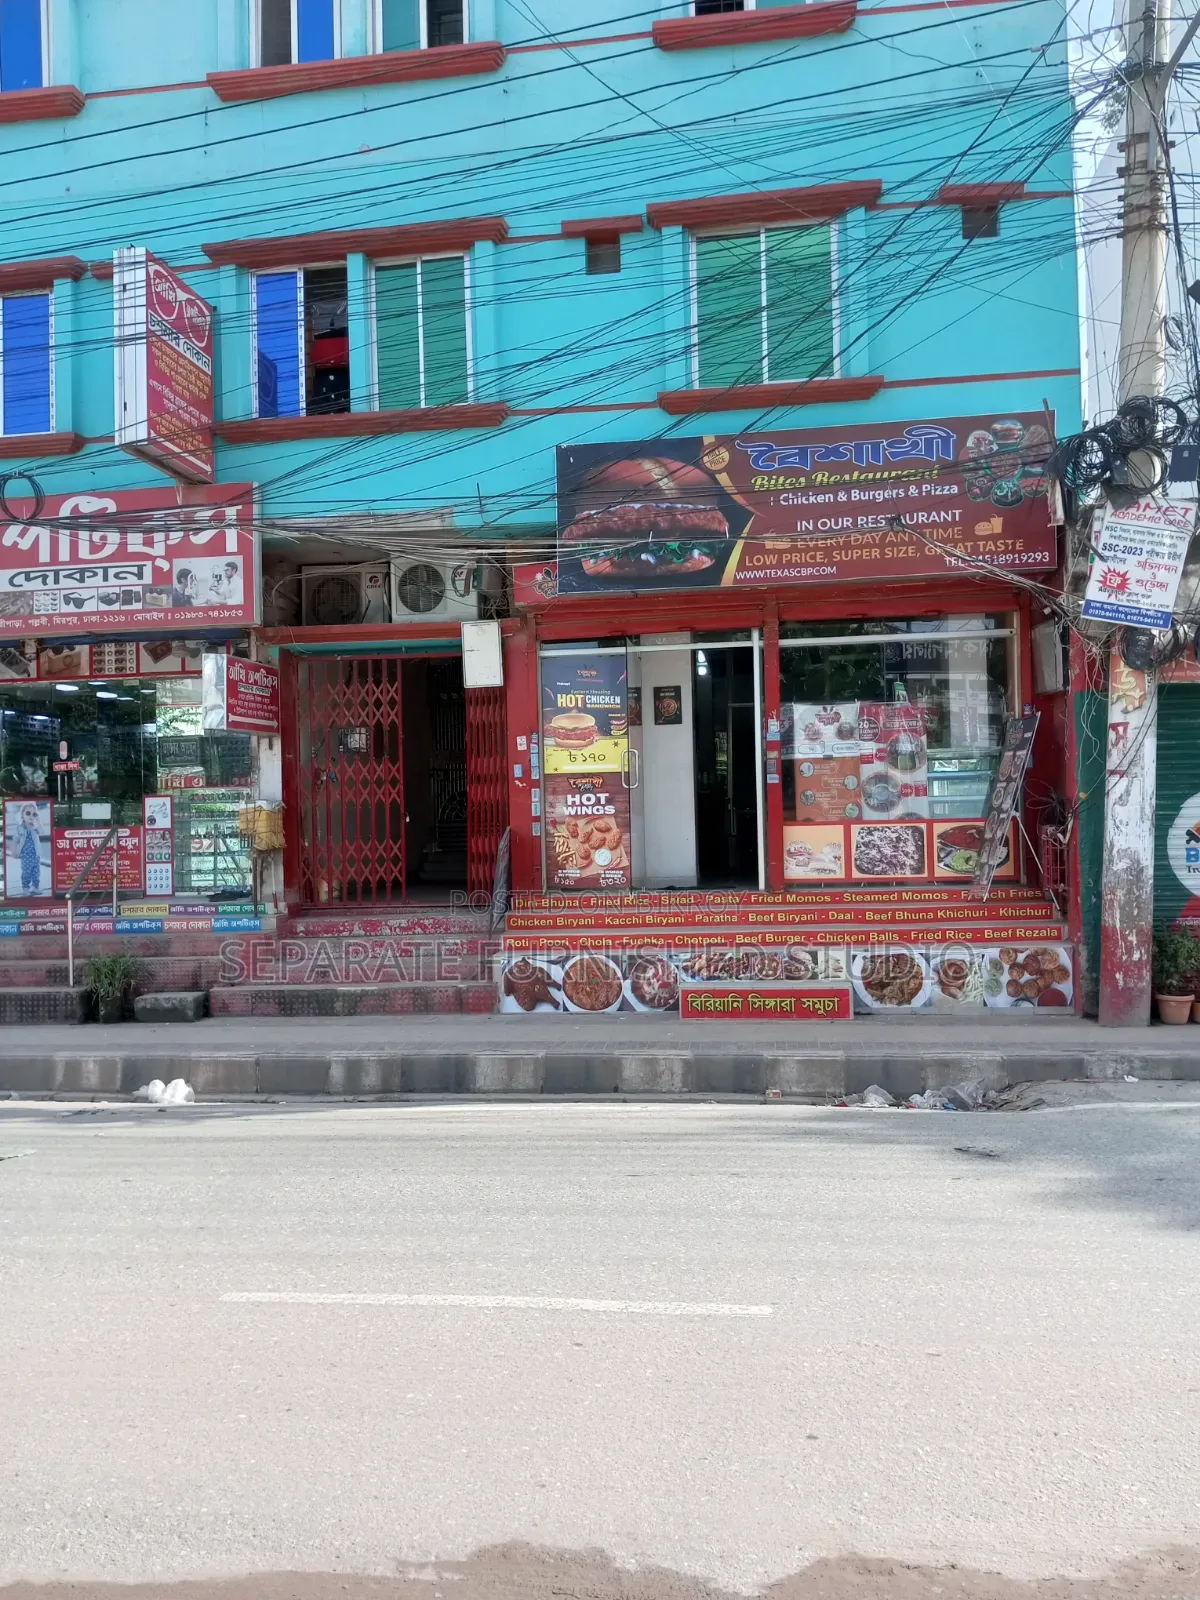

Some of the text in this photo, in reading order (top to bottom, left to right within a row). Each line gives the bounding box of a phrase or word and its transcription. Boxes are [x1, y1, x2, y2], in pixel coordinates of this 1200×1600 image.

[183, 338, 210, 372] দোকান
[735, 424, 956, 471] বৈশাখী
[710, 455, 727, 467] PRICE
[751, 475, 806, 491] Bites
[779, 483, 959, 506] Chicken & Burgers & Pizza
[797, 520, 814, 532] IN
[817, 517, 853, 531] OUR
[1110, 510, 1162, 524] ACADEMIC
[1104, 524, 1118, 533] HSC
[850, 532, 884, 546] DAY
[745, 554, 779, 567] LOW
[782, 551, 829, 566] PRICE,
[832, 548, 882, 563] SUPER
[884, 545, 921, 560] SIZE,
[977, 538, 1024, 552] TASTE
[1101, 542, 1143, 556] SSC-2023
[8, 563, 147, 588] দোকান
[735, 566, 837, 580] WWW.TEXASCBP.COM
[557, 693, 621, 708] HOT CHICKEN
[566, 793, 609, 805] HOT
[563, 805, 616, 815] WINGS
[56, 839, 70, 849] ডাঃ
[73, 838, 88, 850] মোঃ
[517, 898, 538, 908] Dim
[541, 898, 579, 908] Bhuna
[590, 897, 620, 907] Fried
[624, 896, 650, 906] Rice
[661, 895, 694, 905] Salad
[705, 894, 740, 904] Pasta
[751, 894, 782, 903] Fried
[786, 893, 831, 902] Momos
[843, 892, 898, 901] Steamed
[902, 891, 948, 900] Momos
[1010, 889, 1042, 898] Fries
[188, 920, 211, 929] দোকান
[510, 906, 1051, 928] Chicken Biryani Kacchi Biryani Paratha Beef Biryani Daal Beef Bhuna Khichuri Khichuri
[507, 928, 1058, 947] Roti Poori Chola Fuchka Chotpoti Beef Burger Chicken Balls Fried Rice Beef Rezala
[687, 992, 840, 1016] বিরিয়ানি সিঙ্গারা সমুচা
